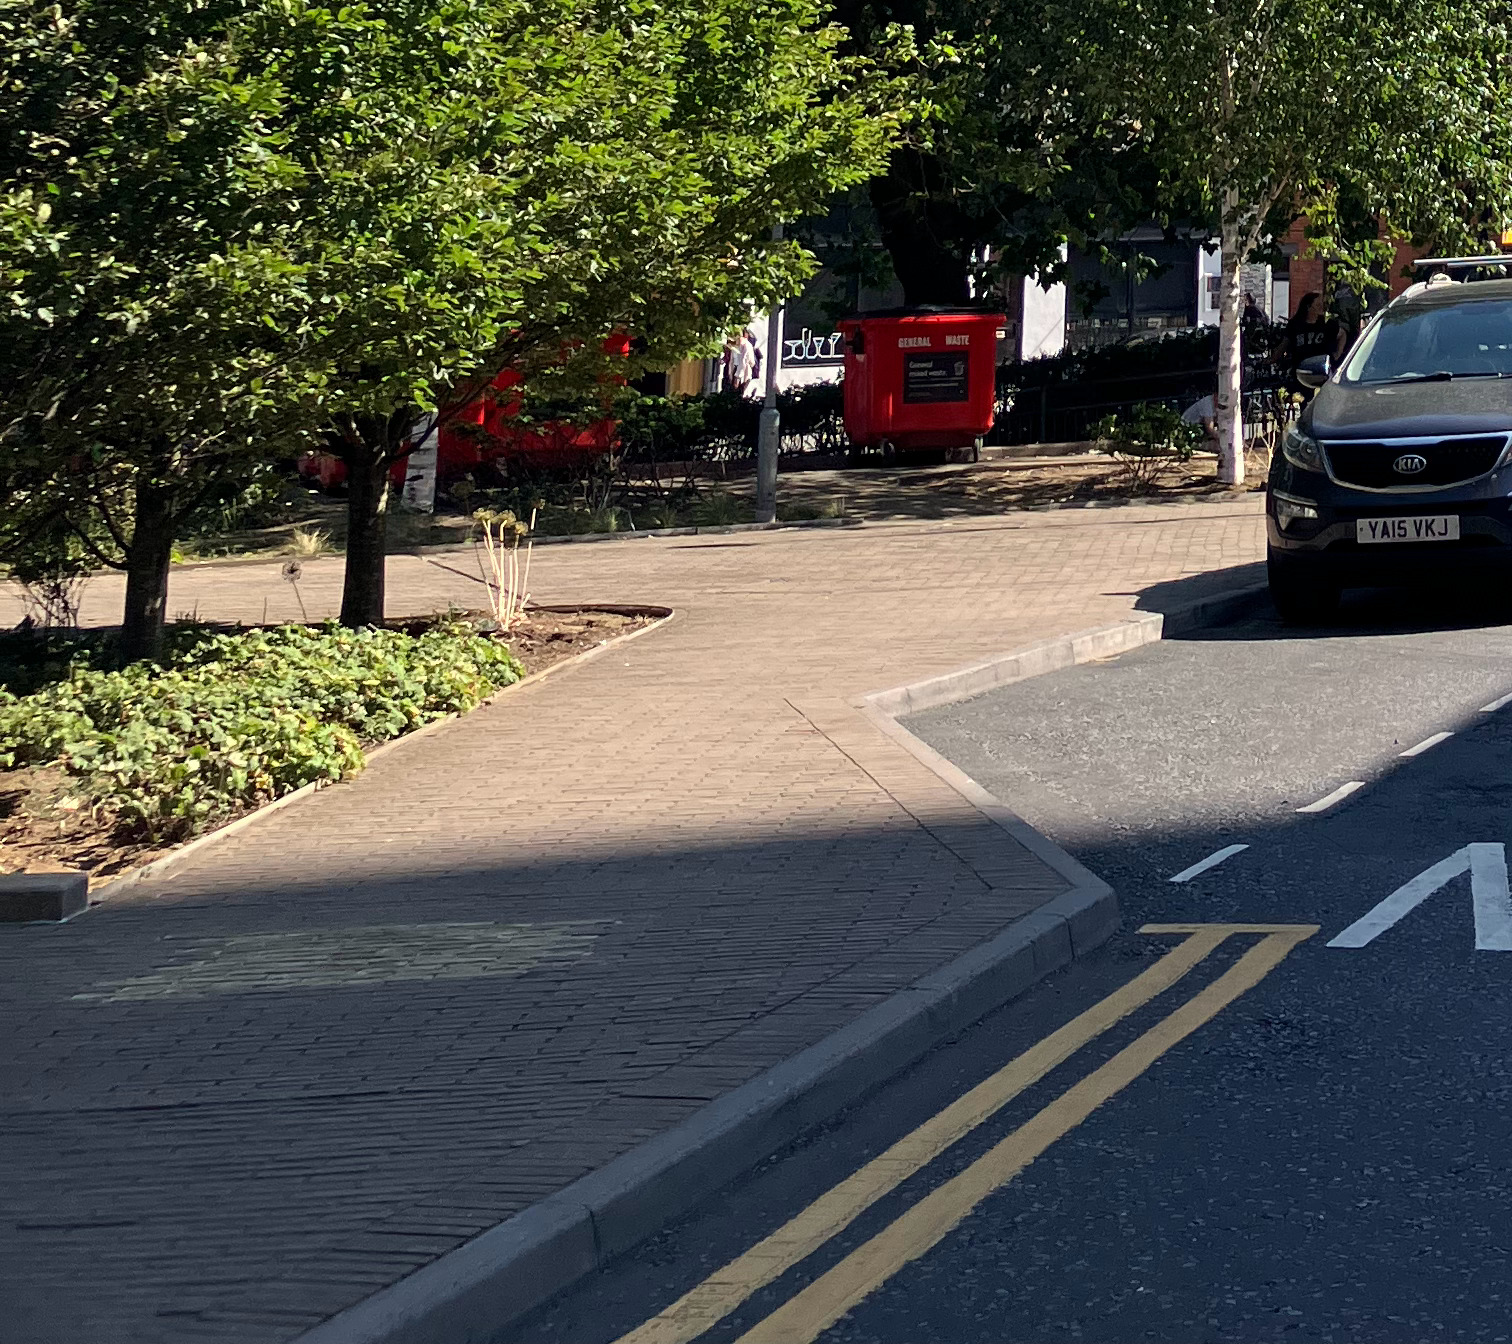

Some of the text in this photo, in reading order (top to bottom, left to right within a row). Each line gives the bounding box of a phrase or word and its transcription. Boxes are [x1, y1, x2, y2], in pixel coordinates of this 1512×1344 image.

[898, 335, 970, 348] GENERAL WASTE
[1398, 457, 1421, 470] KIA
[1368, 518, 1449, 539] YA15 VKJ
